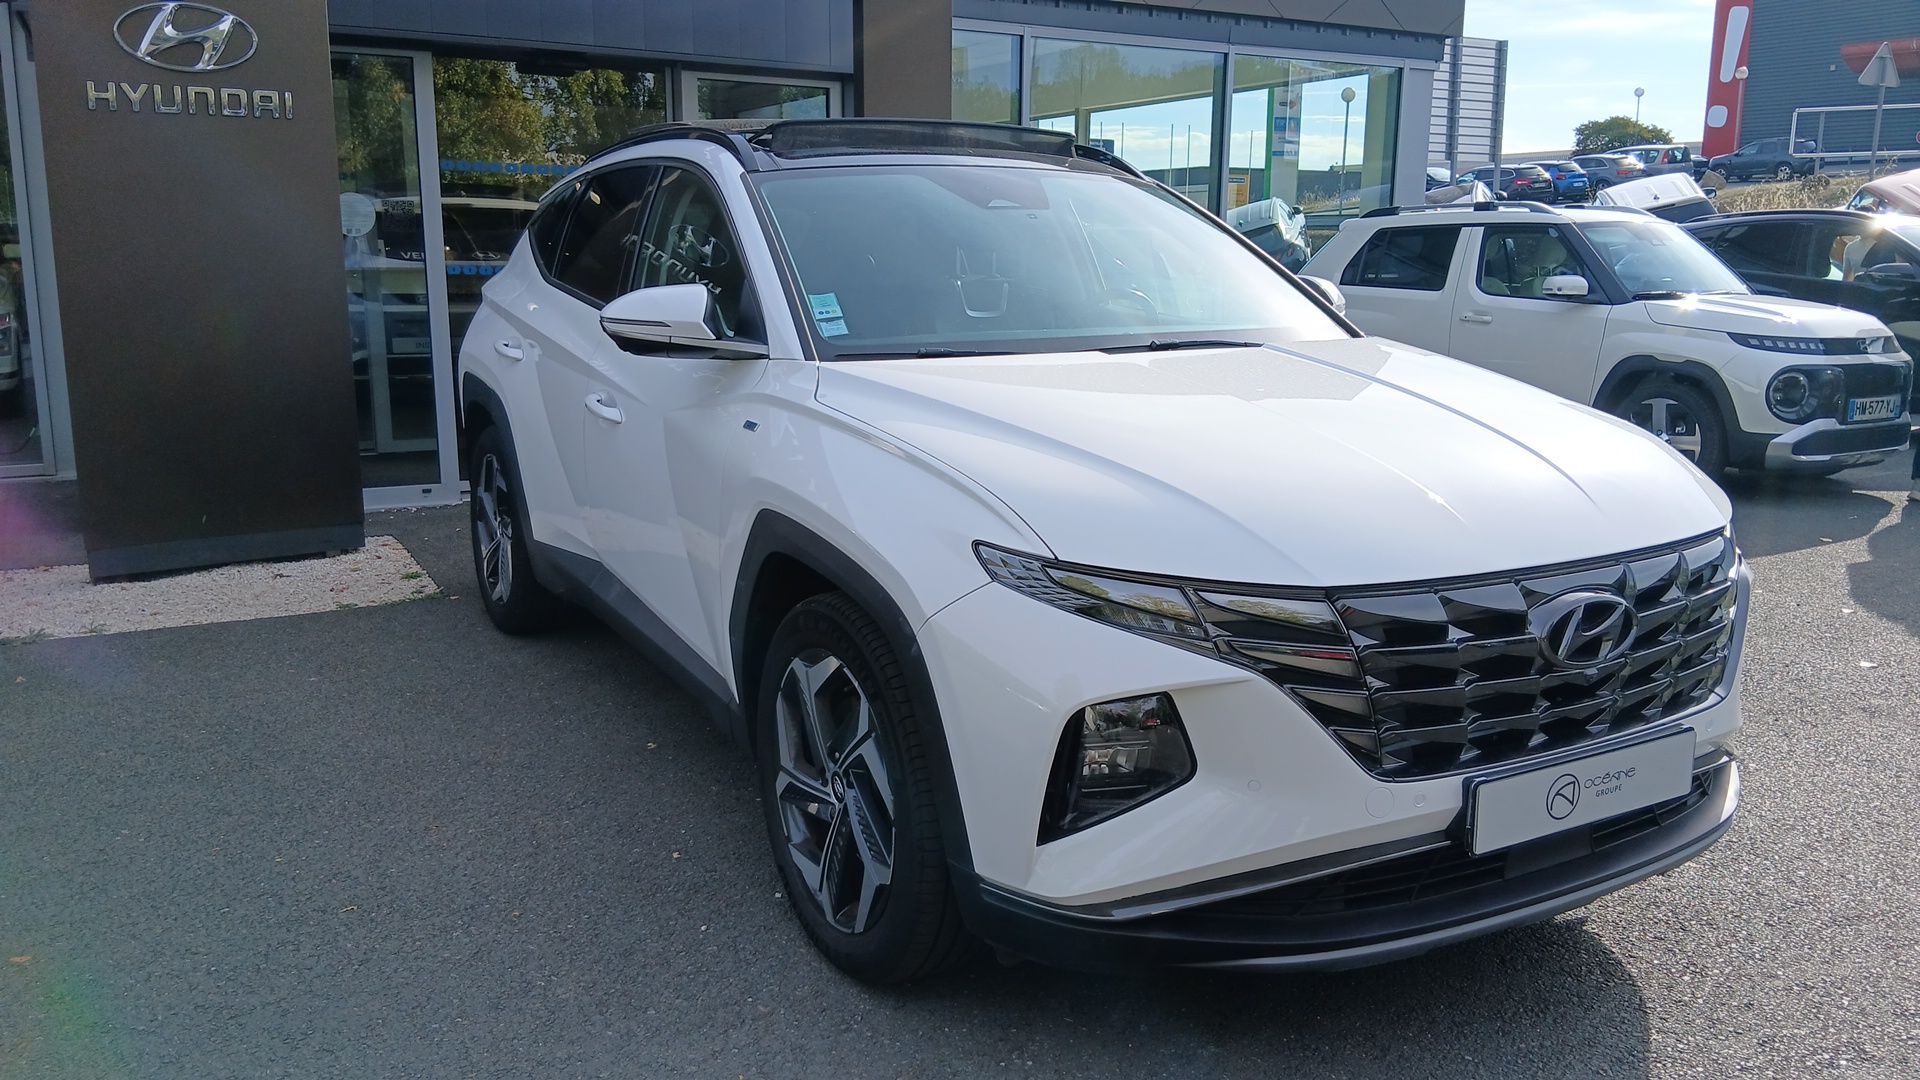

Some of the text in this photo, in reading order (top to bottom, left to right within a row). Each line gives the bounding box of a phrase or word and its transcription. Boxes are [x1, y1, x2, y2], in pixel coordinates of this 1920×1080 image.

[86, 80, 293, 119] HYUNDAI
[400, 251, 425, 260] VE
[1595, 783, 1623, 798] GROUPE
